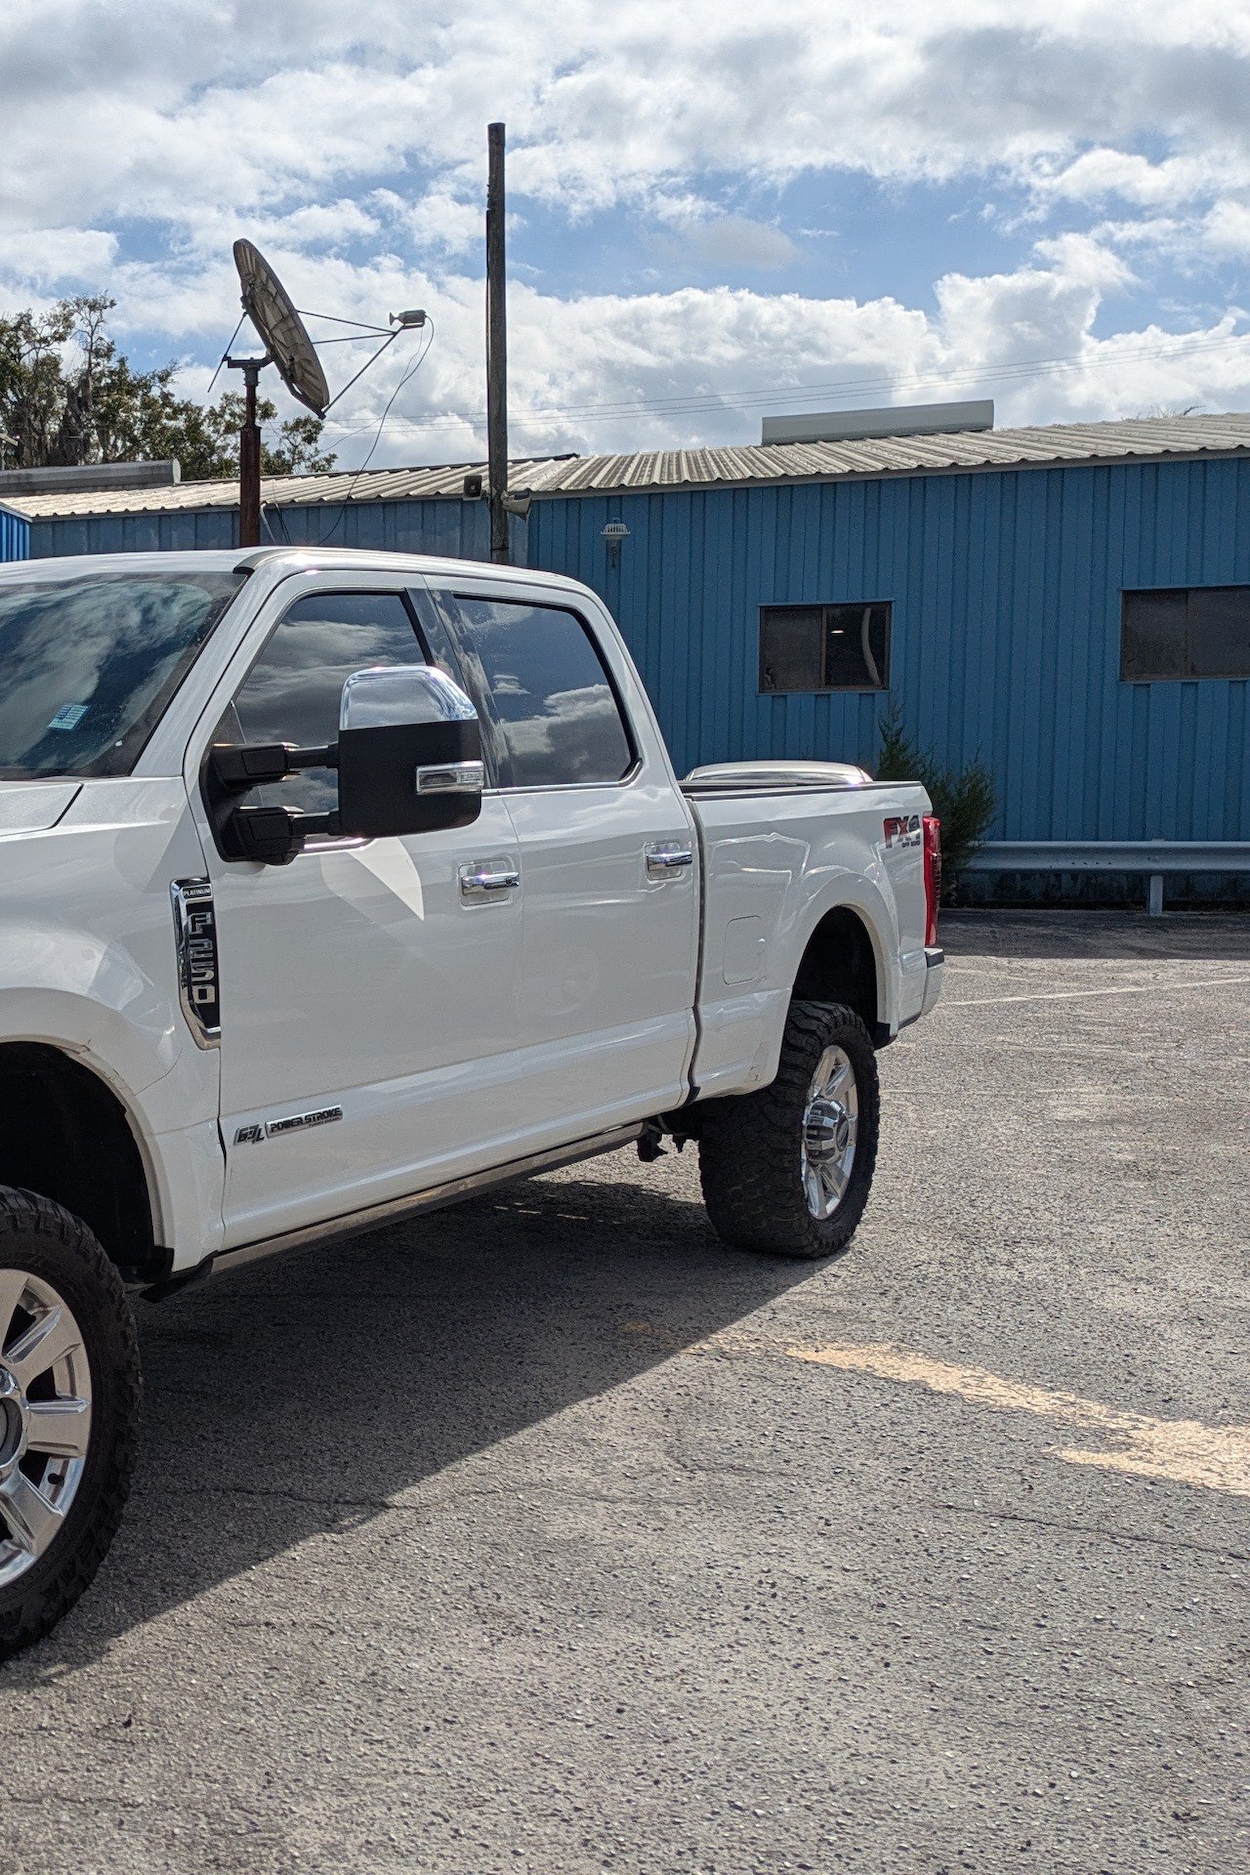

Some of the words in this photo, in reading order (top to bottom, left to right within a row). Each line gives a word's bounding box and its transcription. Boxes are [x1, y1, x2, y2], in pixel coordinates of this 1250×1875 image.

[883, 814, 921, 848] FX4
[183, 887, 211, 897] PLATINUM
[270, 1116, 304, 1133] POWER
[304, 1107, 341, 1124] STROKE
